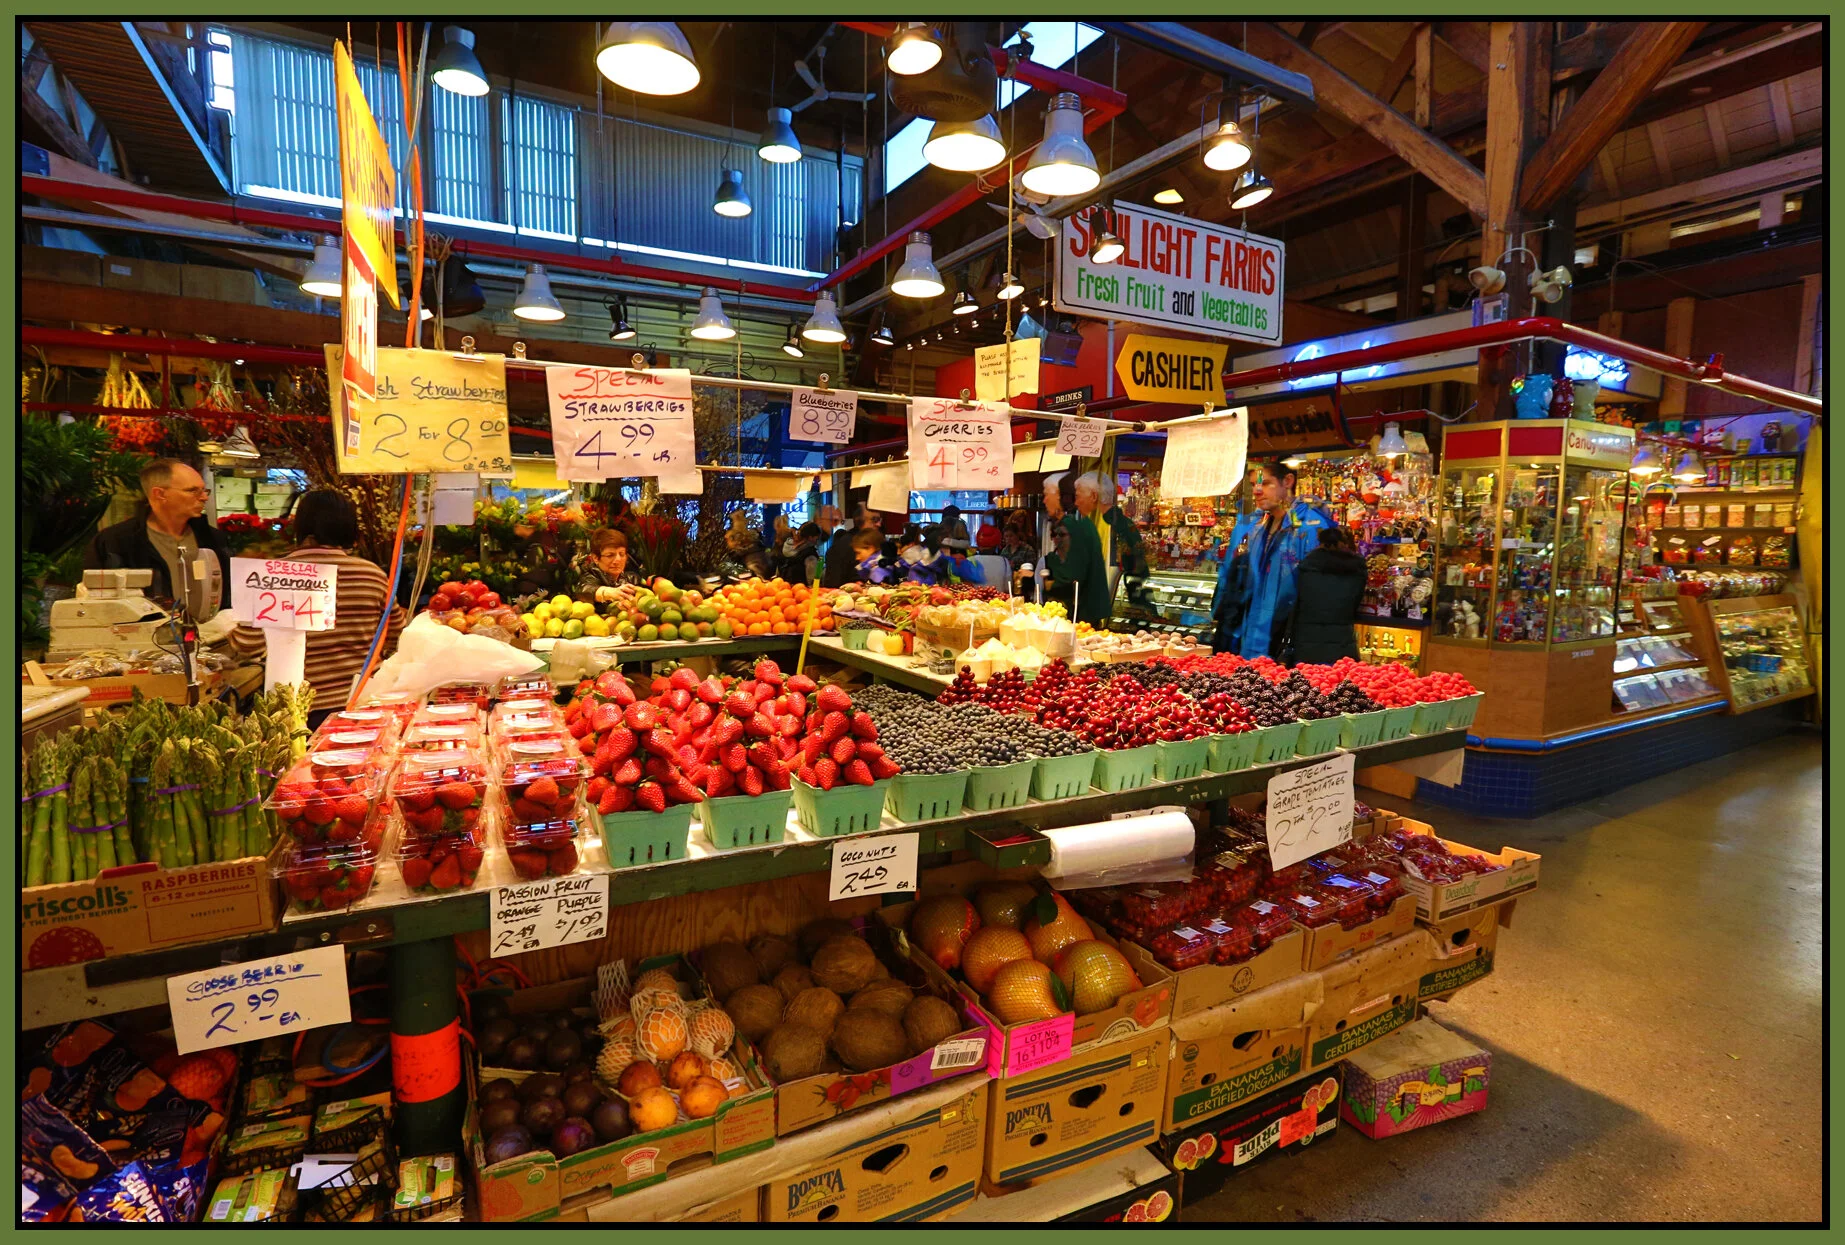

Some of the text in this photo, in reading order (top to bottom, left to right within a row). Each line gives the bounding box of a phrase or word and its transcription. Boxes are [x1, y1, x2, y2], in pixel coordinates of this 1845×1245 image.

[1070, 206, 1275, 296] SNLIGHT FARMS
[1077, 267, 1268, 331] Fresh Fruit and Vegetables
[573, 368, 664, 394] SPECIAL
[1131, 350, 1214, 392] CASHIER
[411, 375, 506, 400] Strawberries
[1055, 391, 1083, 404] DRINKS
[799, 393, 853, 410] Blueberries
[373, 413, 410, 458] 2
[418, 426, 440, 441] For
[802, 409, 850, 440] 8.99 LB
[924, 423, 993, 437] CHERRIES
[246, 571, 329, 589] Asparagus
[265, 561, 318, 573] SPECIAL
[256, 591, 278, 622] 2
[295, 595, 324, 626] 4
[1294, 764, 1333, 784] SPECIAL
[1272, 776, 1345, 810] GRAPE TOMATOES
[1274, 819, 1295, 853] 2
[841, 851, 864, 863] COCO
[142, 865, 256, 892] RASPBERRIES
[23, 886, 128, 920] riscoll's
[499, 878, 594, 906] PASSION FRUIT
[557, 895, 602, 913] PURPLE
[30, 919, 48, 927] THE
[52, 913, 85, 924] FINEST
[497, 903, 543, 920] ORANGE
[187, 974, 238, 994] GOOSE
[1434, 960, 1477, 983] BANANAS
[1420, 977, 1458, 996] CERTIFIED
[1024, 1032, 1043, 1043] LOT
[1341, 1011, 1394, 1042] BANANAS
[1324, 1032, 1370, 1060] CERTIFIED
[1189, 1087, 1245, 1116] CERTIFIED
[1246, 1066, 1290, 1095] ORGANIC
[1210, 1063, 1275, 1097] BANANAS
[1005, 1102, 1053, 1135] BONITA
[1238, 1120, 1280, 1158] PRIDE
[1248, 1139, 1272, 1159] RIVER
[787, 1168, 846, 1211] BONITA
[787, 1204, 818, 1219] PREMIUM
[816, 1193, 846, 1208] BANANAS
